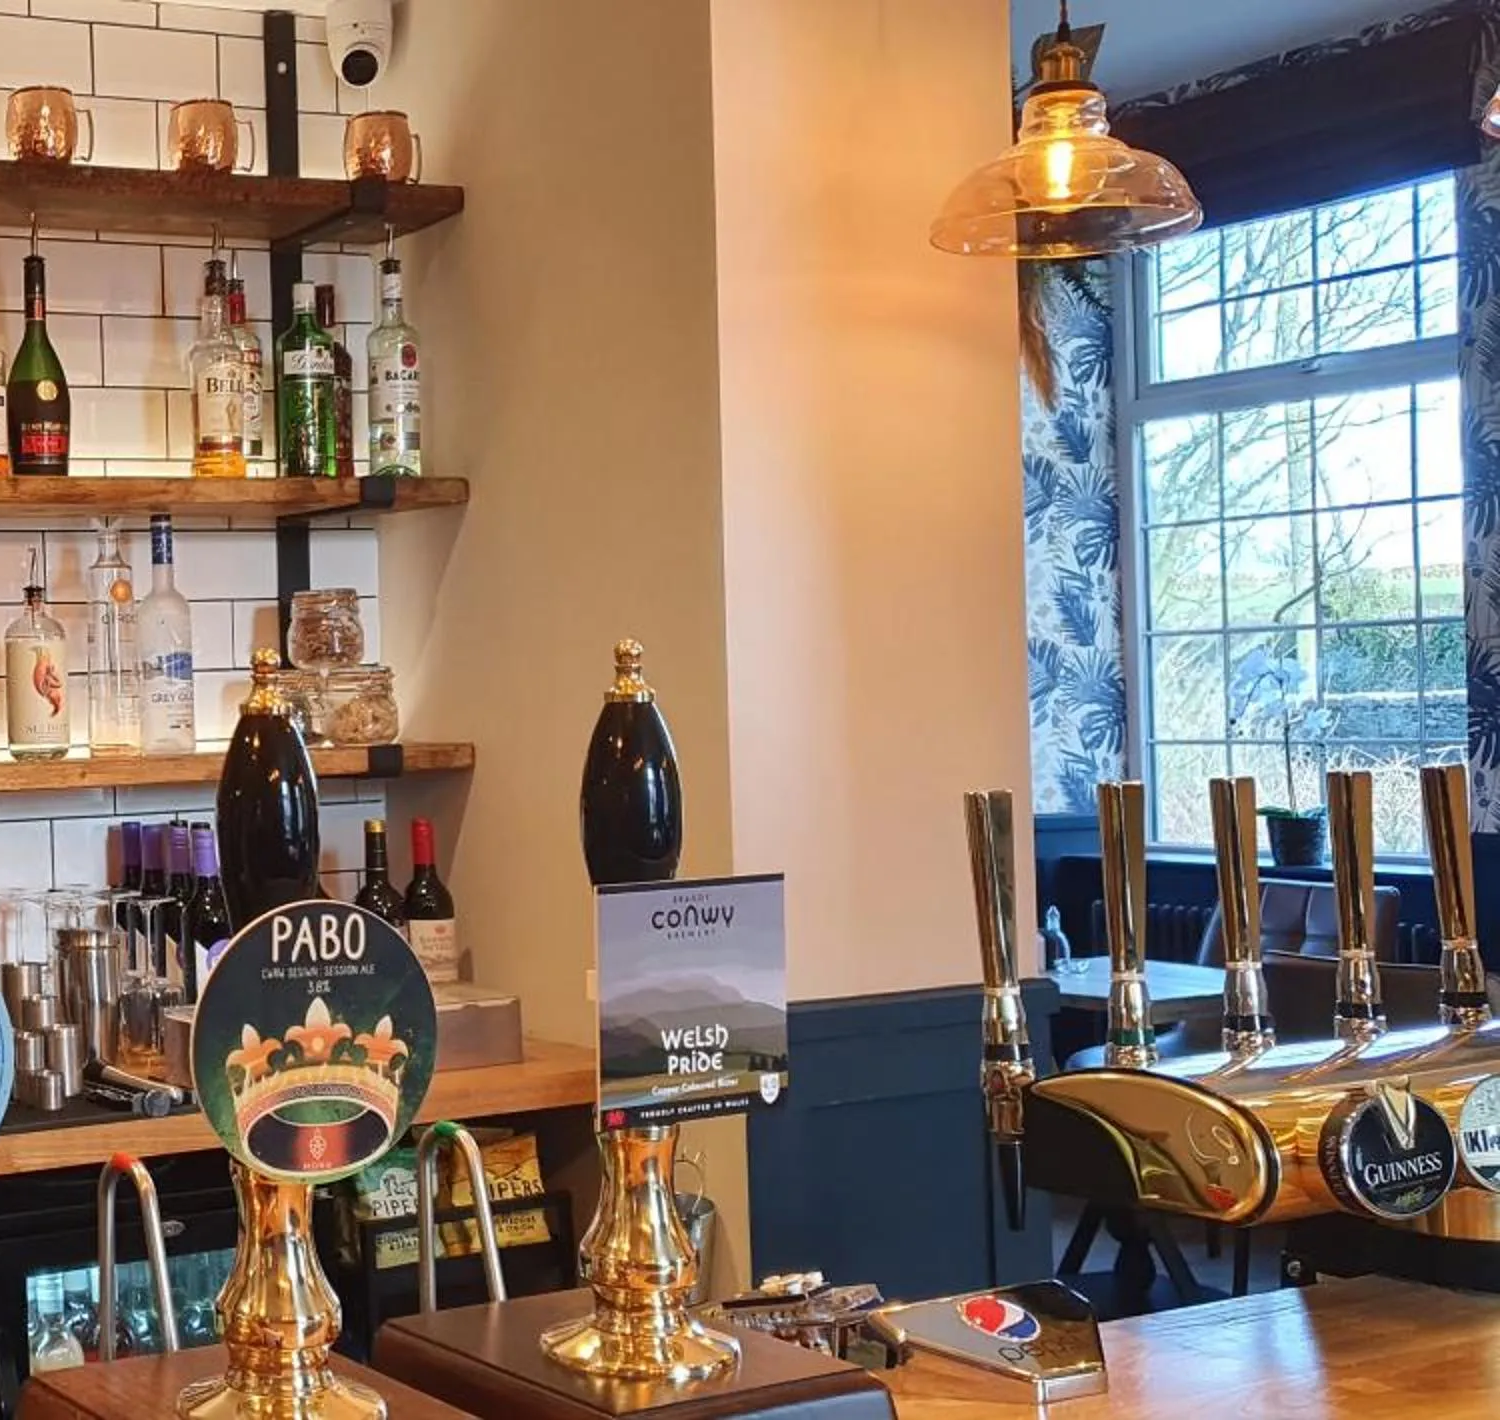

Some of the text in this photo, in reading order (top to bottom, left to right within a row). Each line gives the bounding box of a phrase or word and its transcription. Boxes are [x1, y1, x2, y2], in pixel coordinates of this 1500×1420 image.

[271, 913, 367, 963] PABO
[1363, 1152, 1443, 1187] GUINNESS
[489, 1177, 546, 1200] IPERS
[372, 1197, 420, 1217] PIPE
